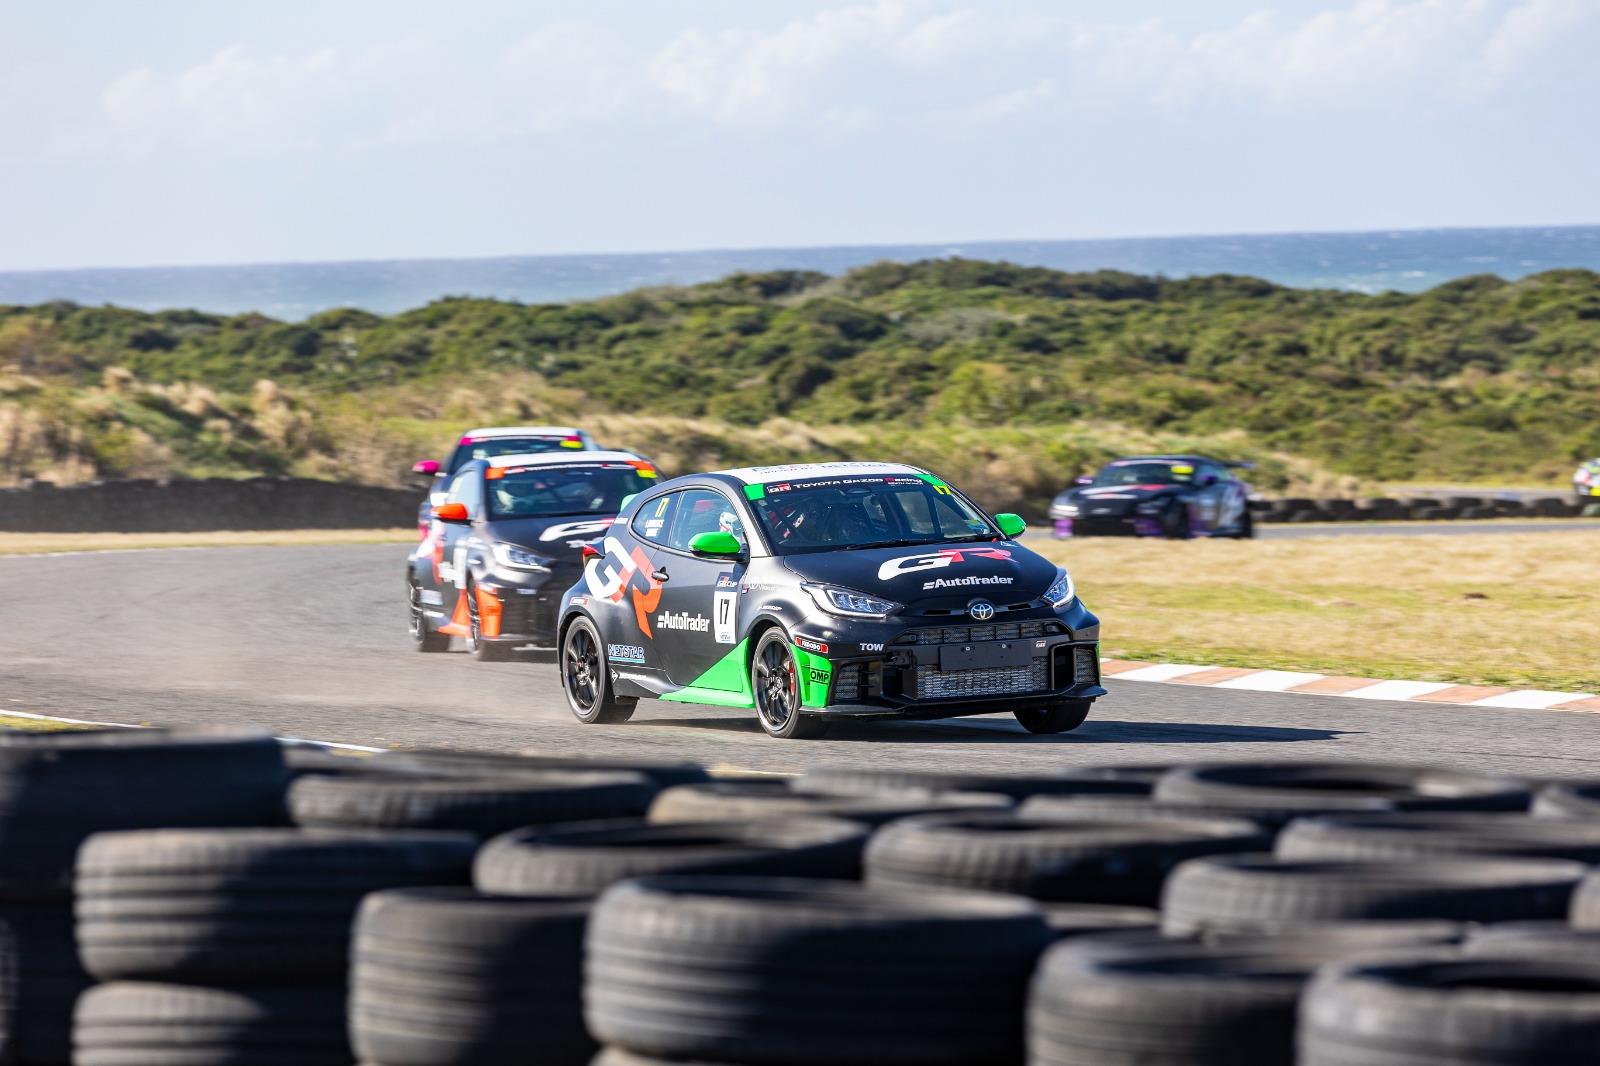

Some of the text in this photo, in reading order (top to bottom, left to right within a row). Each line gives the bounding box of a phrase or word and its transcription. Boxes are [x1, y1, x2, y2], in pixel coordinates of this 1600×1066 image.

[768, 483, 791, 493] GR
[793, 480, 841, 489] TOYOTA
[933, 485, 951, 495] 17
[655, 498, 669, 518] 17
[877, 547, 1020, 580] GR
[585, 536, 663, 640] GR
[933, 575, 1013, 589] AutoTrader
[719, 598, 730, 625] 17
[663, 610, 710, 633] AutoTrader
[608, 644, 645, 659] NETSTAR
[859, 642, 884, 651] TOW
[810, 671, 829, 682] OMP
